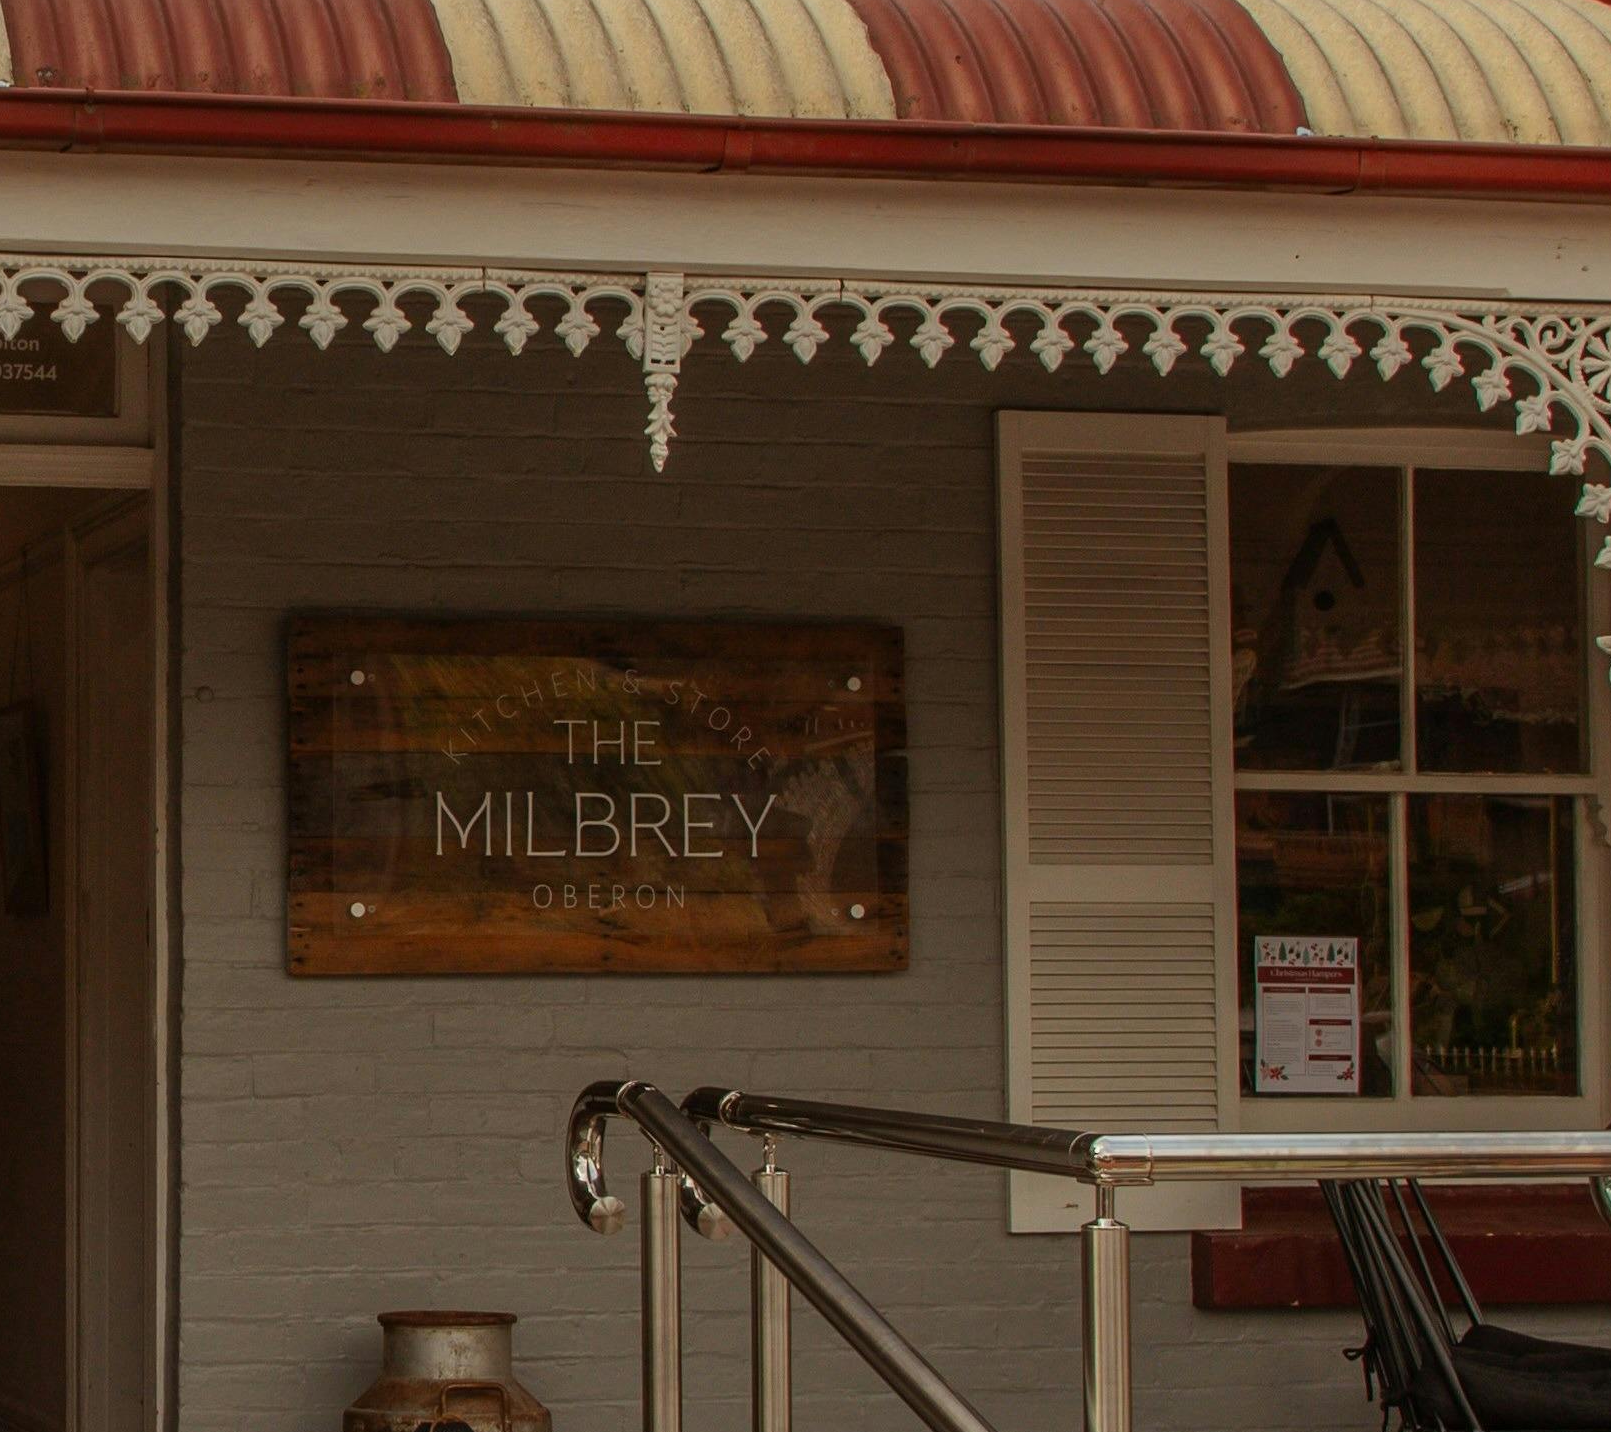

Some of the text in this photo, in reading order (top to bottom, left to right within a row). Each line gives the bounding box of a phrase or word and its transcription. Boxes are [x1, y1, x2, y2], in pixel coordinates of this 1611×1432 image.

[440, 666, 773, 773] KITCHEN & STORE
[552, 719, 663, 766] THE
[435, 790, 779, 859] MILBREY
[532, 883, 686, 910] OBERON
